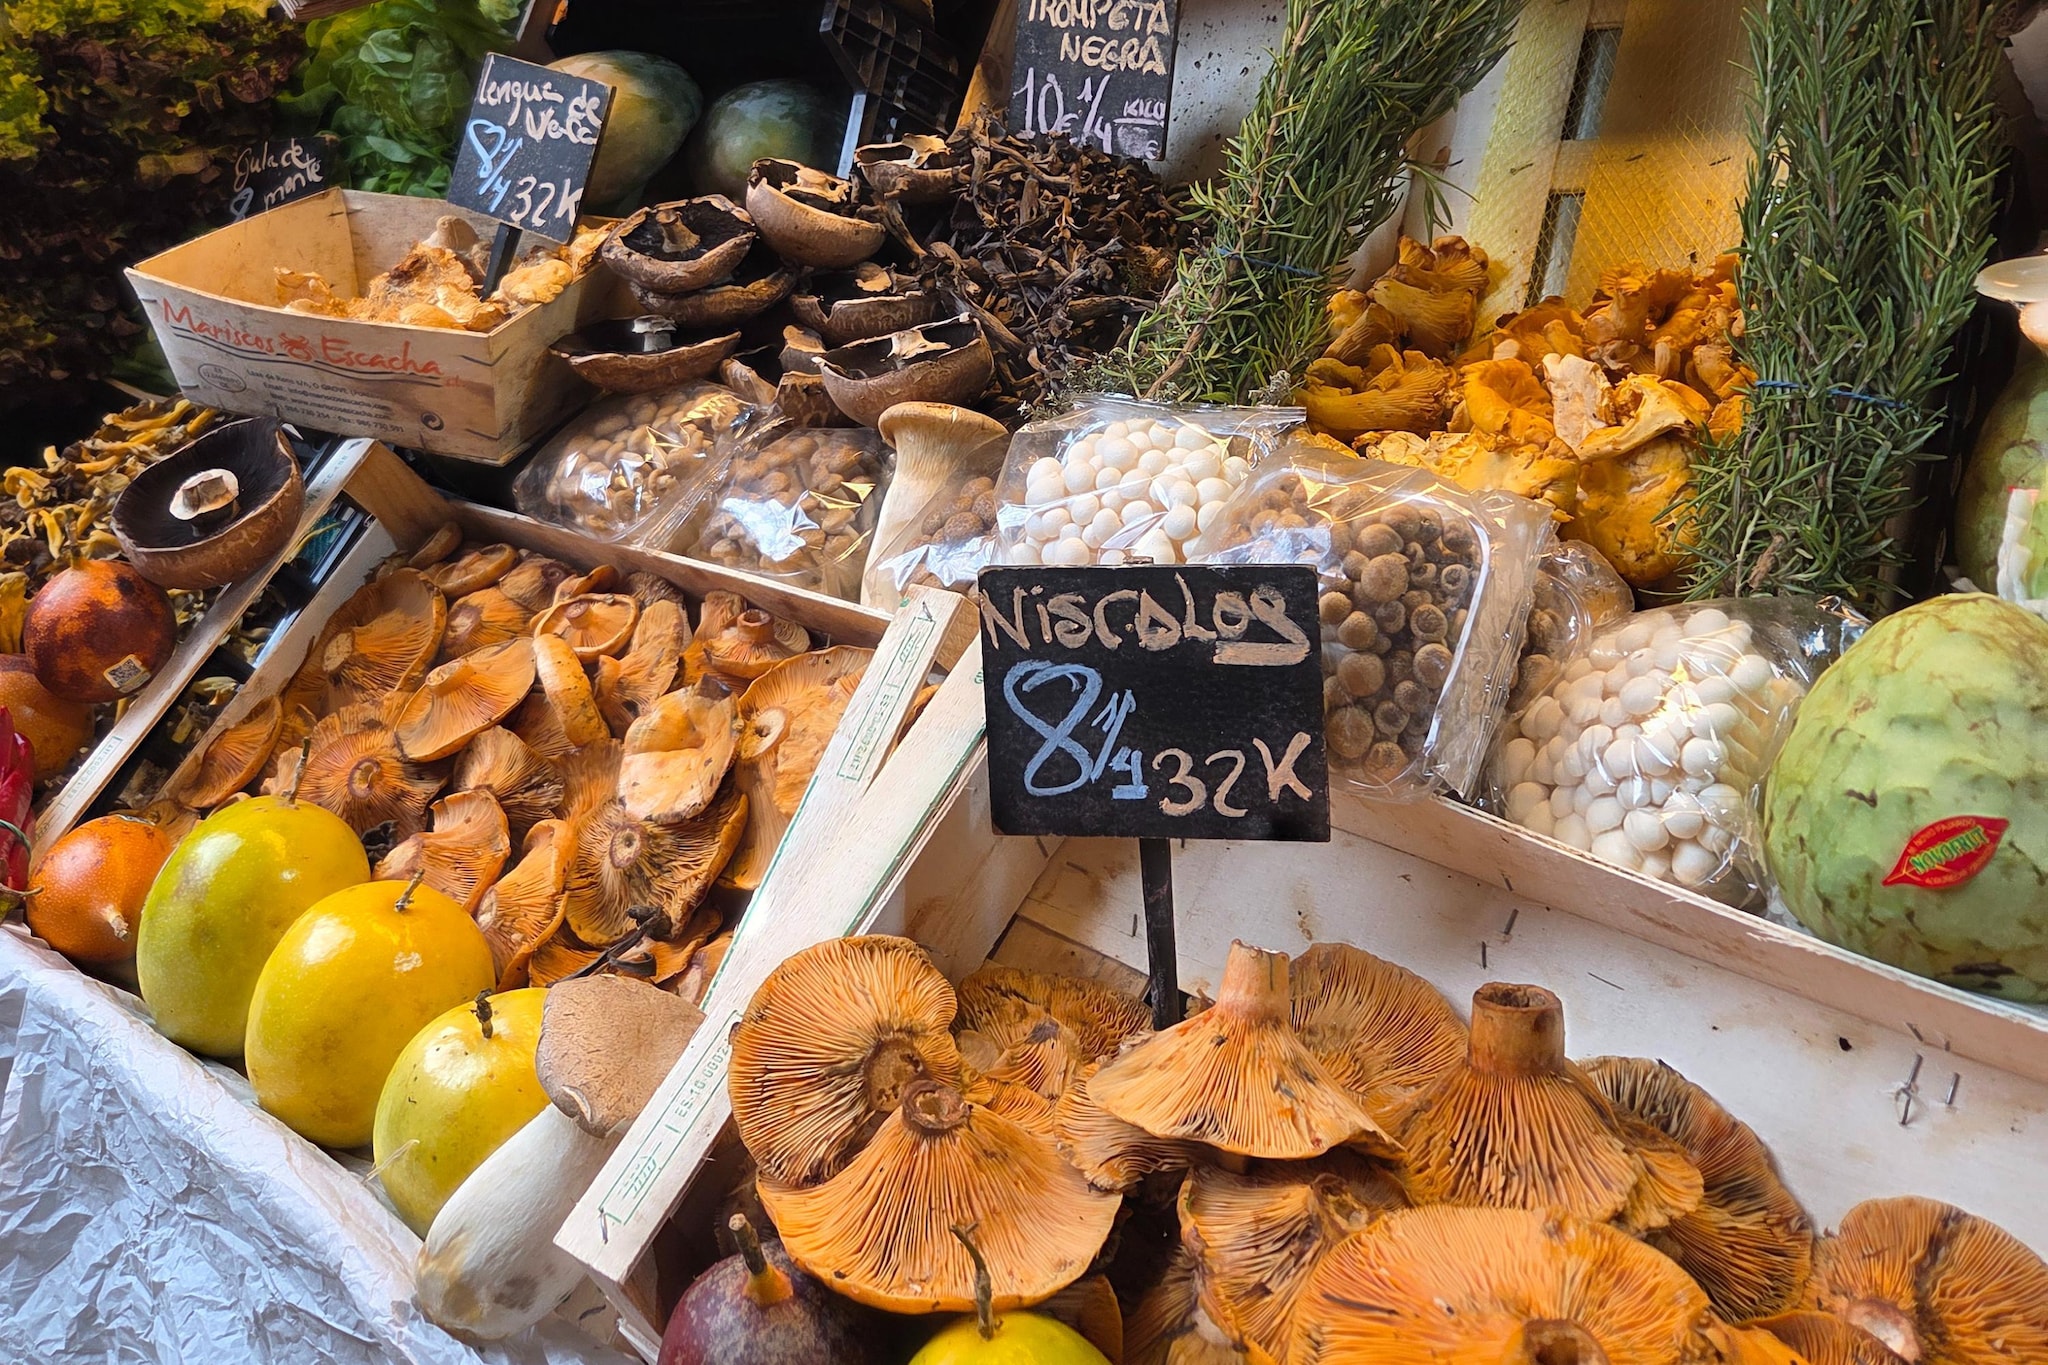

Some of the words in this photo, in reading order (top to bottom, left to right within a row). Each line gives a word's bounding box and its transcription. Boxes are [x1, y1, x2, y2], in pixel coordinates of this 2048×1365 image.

[1059, 32, 1167, 76] NEGRA
[163, 298, 275, 354] Mariscos
[321, 336, 444, 376] Escacha
[1909, 824, 1990, 876] NOVOFRUT
